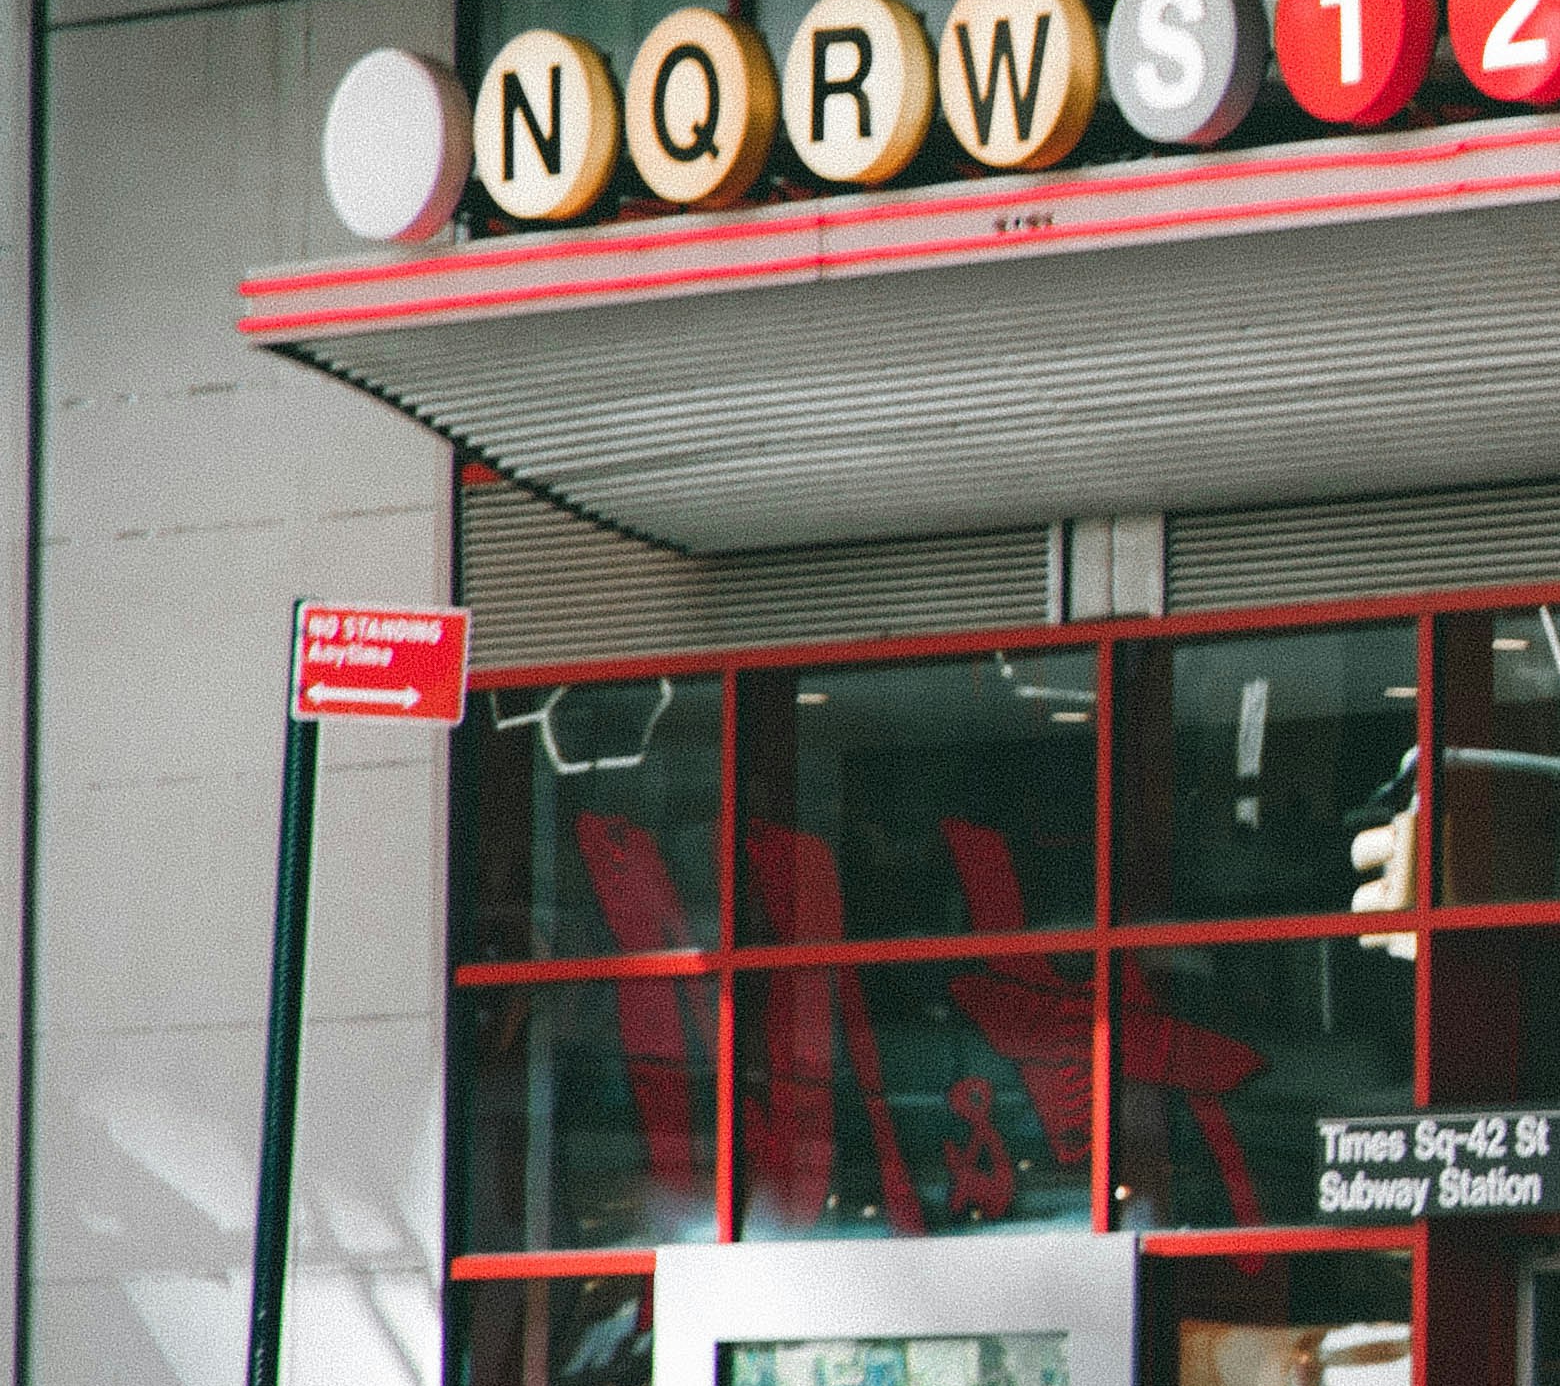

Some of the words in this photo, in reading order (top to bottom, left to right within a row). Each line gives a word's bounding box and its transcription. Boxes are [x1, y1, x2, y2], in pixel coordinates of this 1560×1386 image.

[502, 64, 561, 181] N
[654, 44, 721, 165] Q
[811, 26, 872, 142] R
[956, 13, 1051, 145] W
[308, 615, 340, 639] NO
[343, 616, 443, 645] STANDING
[1318, 1122, 1406, 1165] Times
[1414, 1116, 1507, 1167] Sq-42
[1515, 1115, 1551, 1159] St
[1318, 1168, 1431, 1216] Subway
[1438, 1166, 1542, 1211] Station
